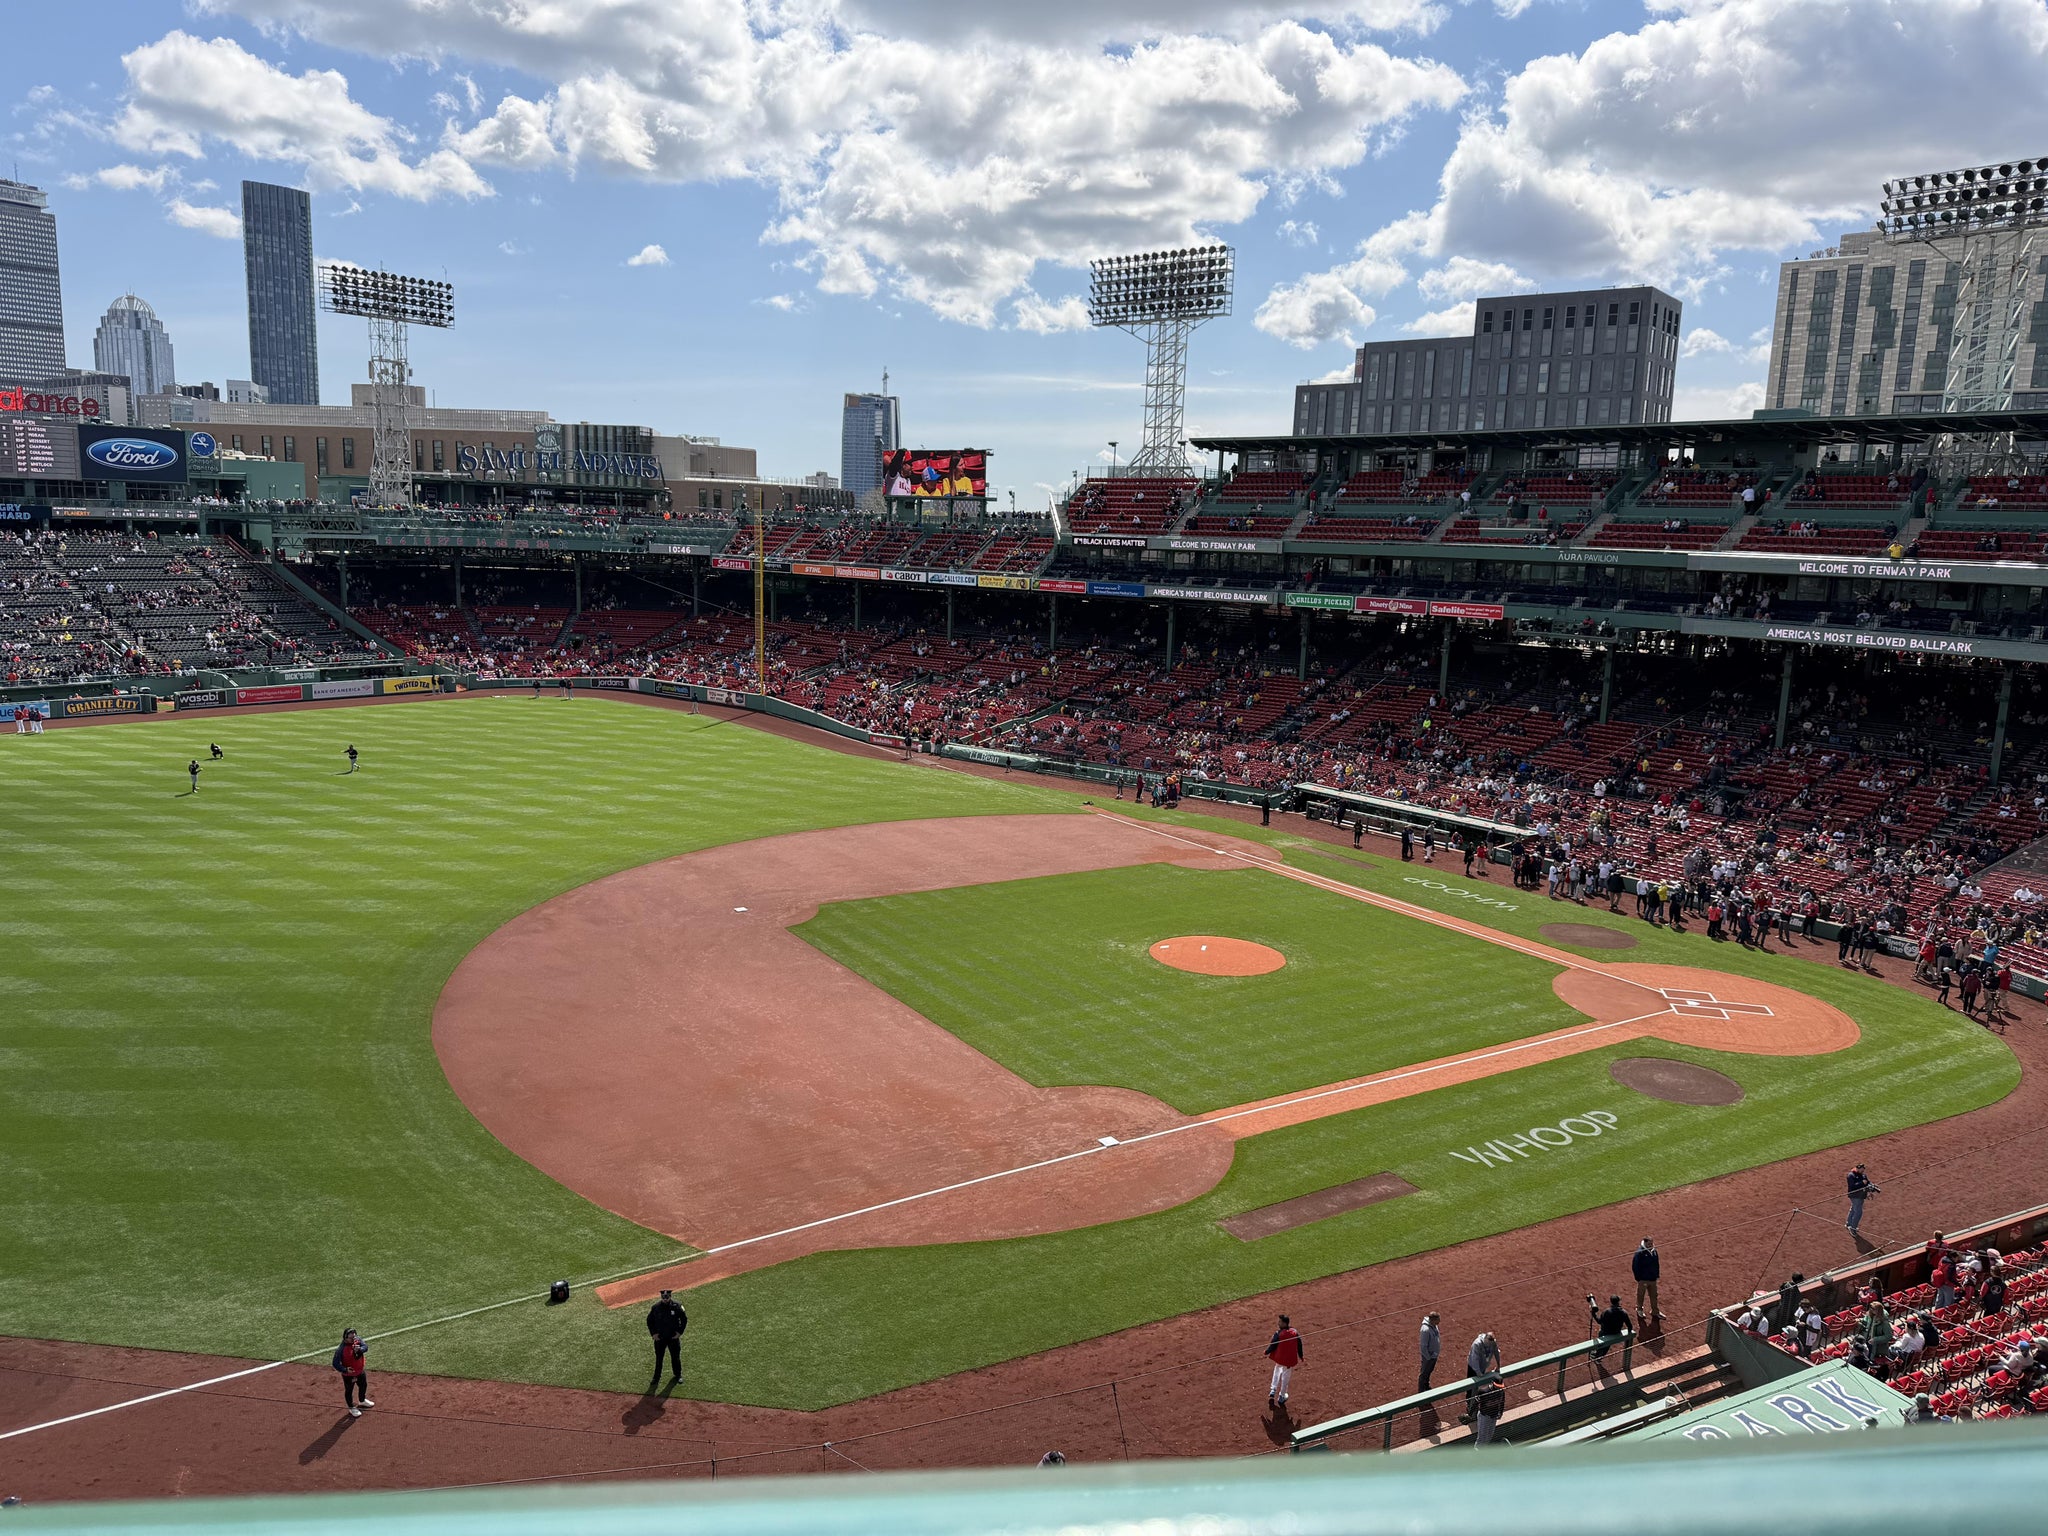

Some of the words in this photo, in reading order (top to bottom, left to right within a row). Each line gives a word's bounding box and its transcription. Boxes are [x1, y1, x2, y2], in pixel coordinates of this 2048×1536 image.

[106, 442, 159, 466] Ford
[460, 446, 566, 472] SAMUEL
[572, 449, 659, 479] ADAMS
[0, 503, 21, 511] GRY
[0, 512, 31, 520] HARD
[1103, 538, 1120, 546] LIVES
[1121, 539, 1146, 547] MATTER
[1170, 541, 1198, 549] WELCOME
[1210, 542, 1236, 550] FENWAY
[1238, 543, 1256, 551] PARK
[668, 546, 691, 554] 10:46
[1584, 554, 1619, 562] PAVILION
[730, 561, 745, 569] PIZZA
[852, 568, 878, 578] Hawaiian
[1799, 563, 1848, 574] WELCOME
[1852, 565, 1866, 575] TO
[1869, 566, 1916, 576] FENWAY
[1919, 567, 1952, 578] PARK
[1153, 588, 1184, 597] AMERICA'S
[1186, 590, 1201, 598] MOST
[1204, 592, 1231, 600] BELOVED
[1234, 593, 1268, 601] BALLPARK
[1324, 598, 1350, 606] PICKLES
[1370, 600, 1388, 608] Ninety
[1399, 602, 1413, 610] Nine
[1432, 605, 1465, 615] Safelite
[1767, 628, 1820, 641] AMERICA'S
[1824, 632, 1852, 643] MOST
[1856, 635, 1906, 647] BELOVED
[1909, 638, 1972, 652] BALLPARK
[285, 672, 303, 680] DICK'S
[394, 680, 419, 691] TWISTED
[419, 680, 430, 689] TEA
[180, 691, 219, 703] wasabi
[67, 699, 113, 713] GRANITE
[116, 698, 138, 710] CITY
[1403, 877, 1519, 911] WHOOP
[1449, 1110, 1618, 1168] WHOOP
